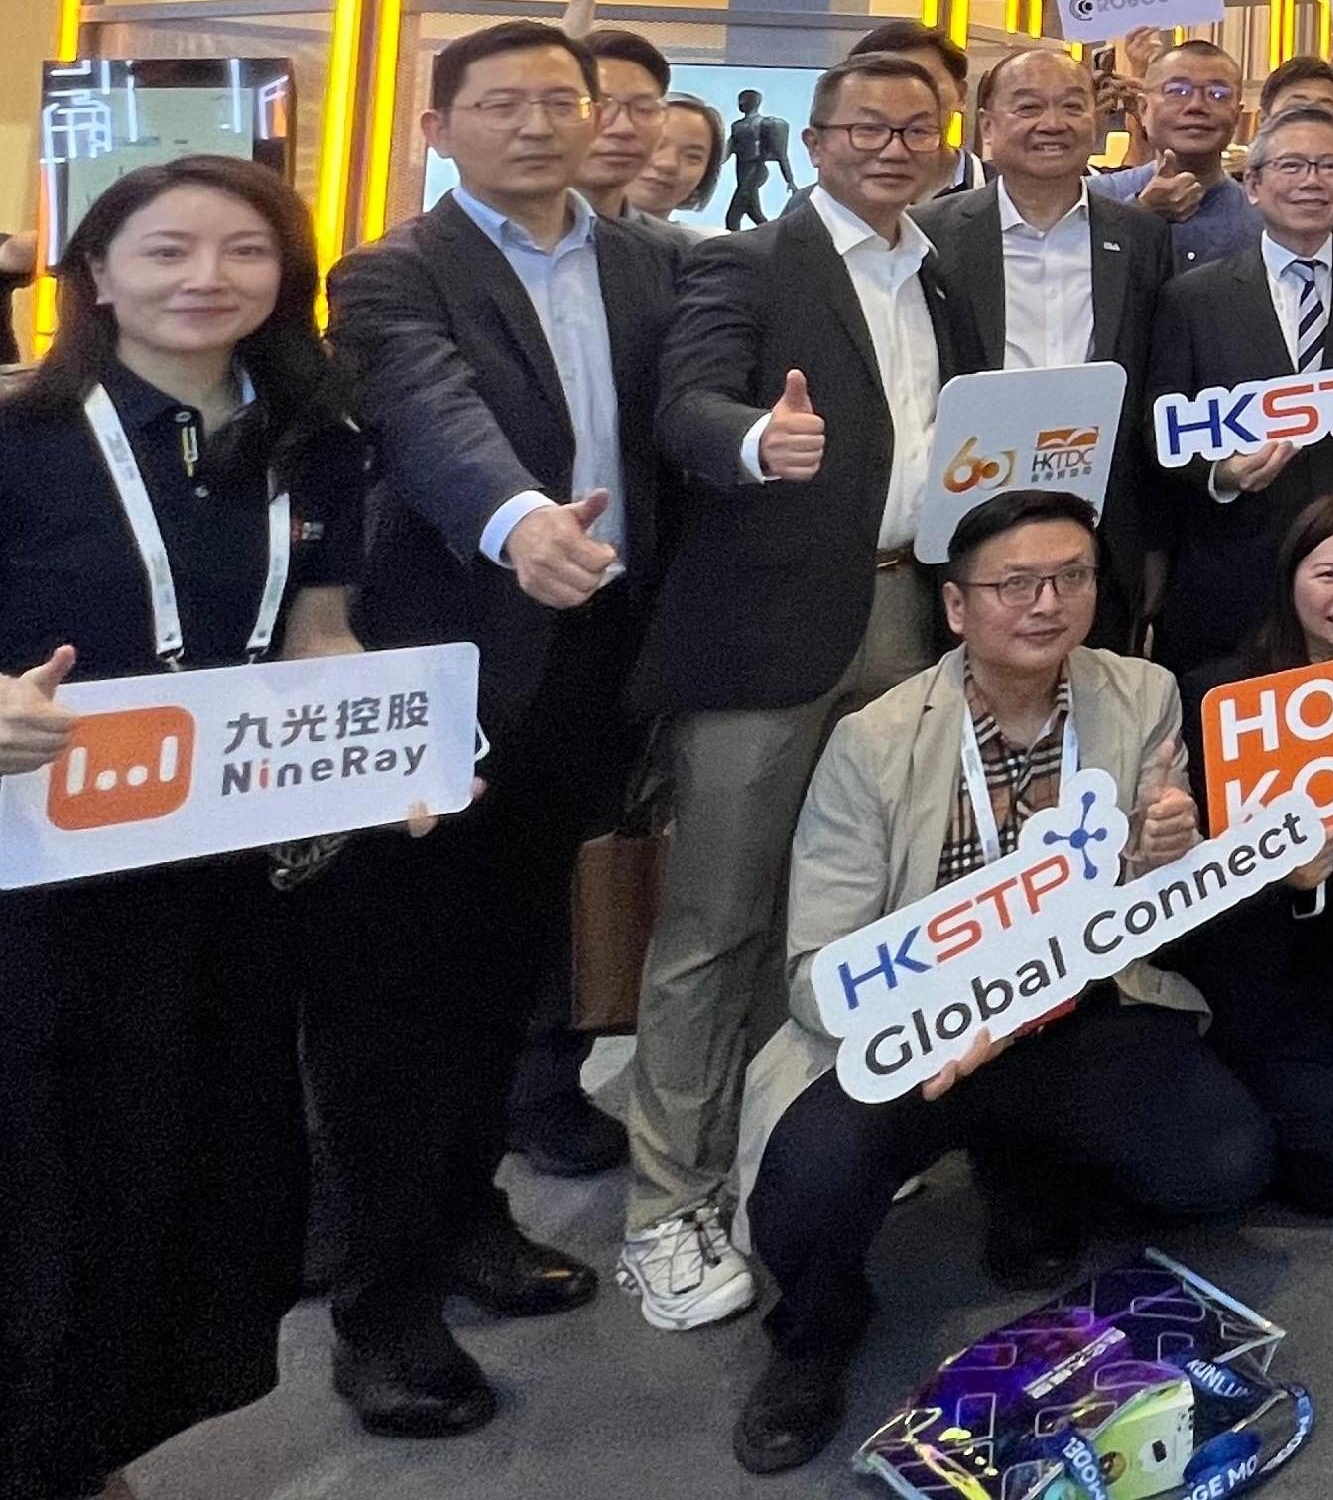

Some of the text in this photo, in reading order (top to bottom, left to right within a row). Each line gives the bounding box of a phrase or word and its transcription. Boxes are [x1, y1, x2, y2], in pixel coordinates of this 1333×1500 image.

[1031, 447, 1096, 473] HKTDC
[222, 689, 430, 755] 九光控股
[220, 741, 428, 798] NineRay
[836, 854, 1072, 1010] HKSTP
[863, 811, 1310, 1077] Global Connect
